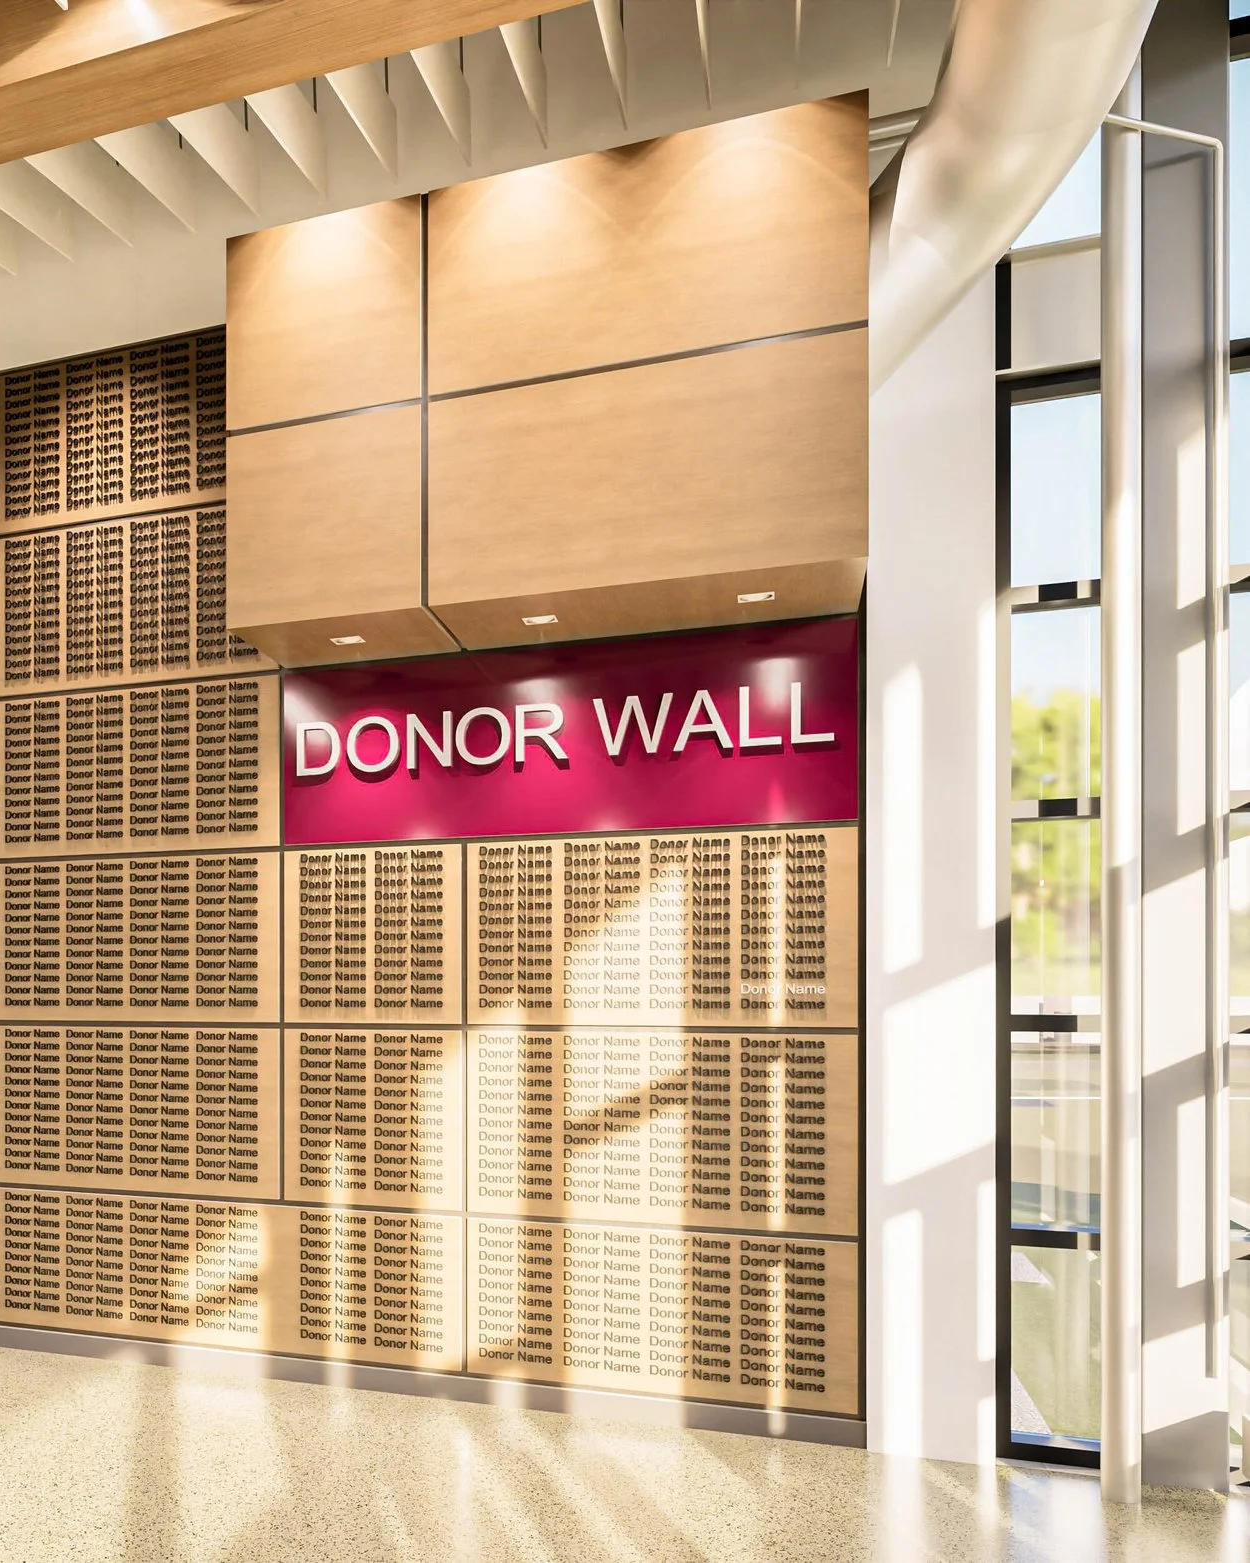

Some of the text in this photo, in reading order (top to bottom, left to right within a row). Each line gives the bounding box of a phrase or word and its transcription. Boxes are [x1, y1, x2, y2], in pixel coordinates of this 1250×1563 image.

[129, 342, 189, 362] Donor Name
[65, 356, 123, 375] Donor Name
[4, 502, 60, 518] Donor Name
[195, 624, 226, 635] Donor
[65, 661, 123, 674] Donor Name
[129, 654, 189, 668] Donor Name
[4, 667, 60, 681] Donor Name
[129, 687, 189, 701] Donor Name
[195, 681, 258, 695] Donor Name
[4, 700, 60, 713] Donor Name
[65, 694, 123, 707] Donor Name
[296, 682, 836, 777] DONOR WALL
[129, 763, 189, 775] Donor Name
[4, 772, 60, 784] Donor Name
[195, 822, 258, 834] Donor Name
[65, 829, 123, 841] Donor Name
[65, 861, 123, 873] Donor Name
[129, 859, 189, 870] Donor Name
[195, 856, 258, 868] Donor Name
[4, 864, 60, 875] Donor Name
[4, 936, 60, 947] Donor Name
[129, 934, 189, 945] Donor Name
[299, 971, 366, 981] Donor Name
[478, 983, 552, 994] Donor Name
[784, 983, 825, 994] Name
[65, 997, 123, 1007] Donor Name
[195, 997, 258, 1007] Donor Name
[299, 997, 366, 1008] Donor Name
[374, 997, 443, 1008] Donor Name
[563, 997, 640, 1009] Donor Name
[649, 998, 730, 1009] Donor Name
[4, 1028, 60, 1038] Donor Name
[65, 1029, 123, 1039] Donor Name
[129, 1029, 189, 1040] Donor Name
[195, 1030, 258, 1041] Donor Name
[299, 1031, 366, 1043] Donor Name
[374, 1032, 443, 1044] Donor Name
[740, 1036, 825, 1049] Donor Name
[374, 1059, 443, 1071] Donor Name
[649, 1079, 730, 1092] Donor Name
[4, 1099, 60, 1111] Donor Name
[299, 1097, 366, 1109] Donor Name
[129, 1104, 189, 1116] Donor Name
[563, 1119, 640, 1133] Donor Name
[65, 1162, 123, 1175] Donor Name
[195, 1169, 258, 1183] Donor Name
[4, 1191, 60, 1204] Donor Name
[478, 1185, 552, 1200] Donor Name
[65, 1195, 123, 1208] Donor Name
[129, 1199, 189, 1213] Donor Name
[195, 1203, 258, 1217] Donor Name
[299, 1210, 366, 1225] Donor Name
[374, 1215, 443, 1230] Donor Name
[649, 1233, 730, 1250] Donor Name
[740, 1239, 825, 1256] Donor Name
[4, 1298, 60, 1313] Donor Name
[195, 1292, 258, 1308] Donor Name
[65, 1304, 123, 1320] Donor Name
[129, 1310, 189, 1326] Donor Name
[299, 1328, 366, 1345] Donor Name
[374, 1335, 443, 1353] Donor Name
[478, 1346, 552, 1364] Donor Name
[563, 1354, 640, 1373] Donor Name
[649, 1363, 730, 1383] Donor Name
[740, 1372, 825, 1393] Donor Name
